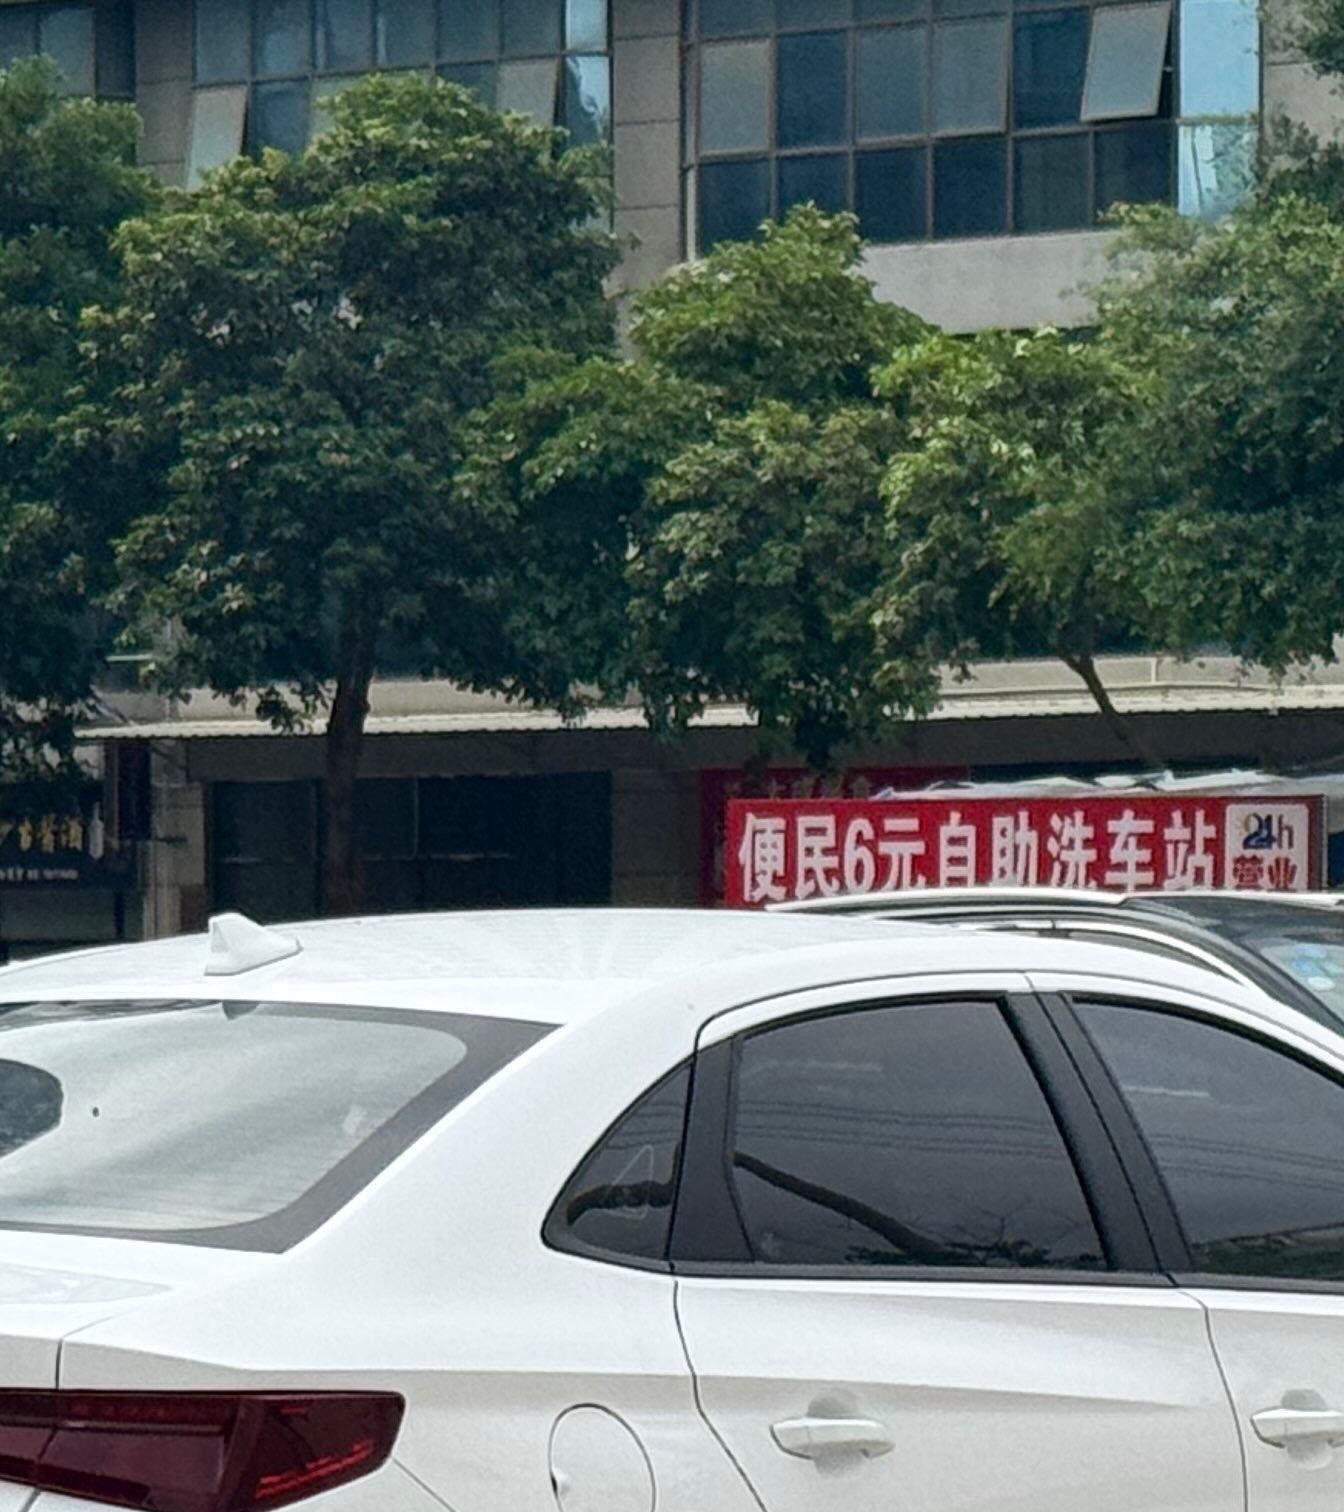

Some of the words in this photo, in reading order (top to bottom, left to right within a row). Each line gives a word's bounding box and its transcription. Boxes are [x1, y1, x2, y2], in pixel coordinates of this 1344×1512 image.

[1242, 813, 1294, 850] 24h
[738, 810, 1216, 902] 便民6元自助洗车站
[1233, 855, 1298, 889] 营业
